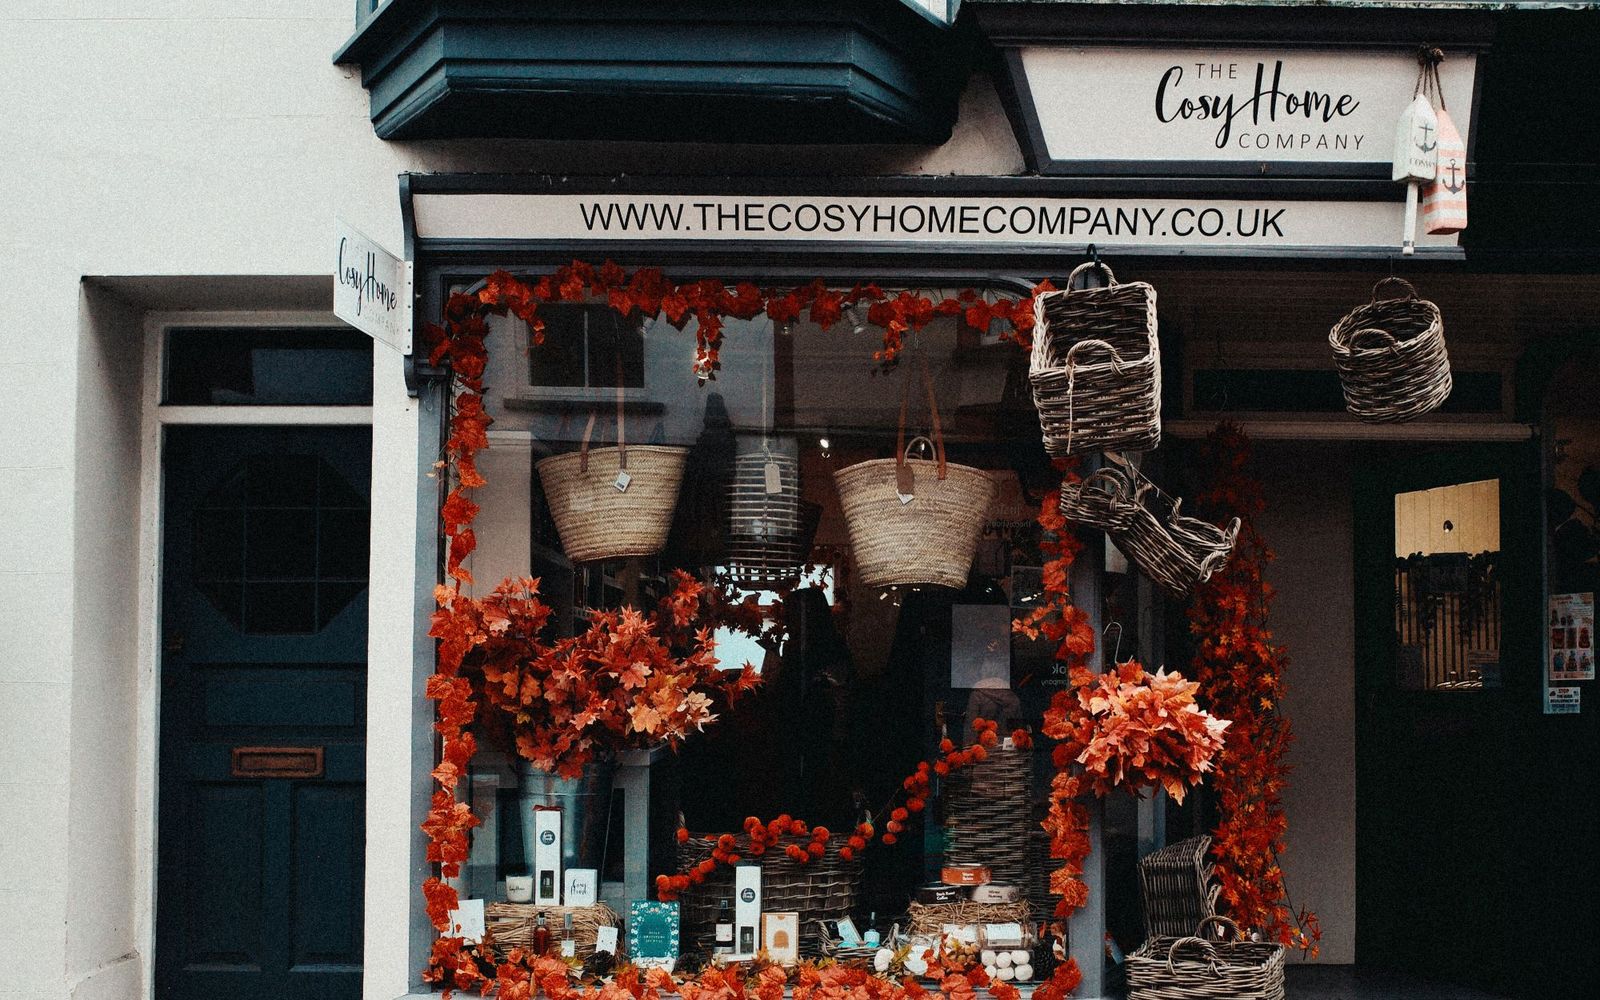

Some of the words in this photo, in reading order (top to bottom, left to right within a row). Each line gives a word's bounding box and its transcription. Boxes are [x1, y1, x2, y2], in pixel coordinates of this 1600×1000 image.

[1195, 63, 1238, 79] THE
[1155, 65, 1234, 149] Cosy
[1252, 60, 1360, 126] Home
[1238, 133, 1364, 150] COMPANY
[580, 203, 1286, 238] WWW.THECOSYHOMECOMPANY.CO.UK
[339, 237, 362, 316] Cosy
[367, 251, 398, 311] Home
